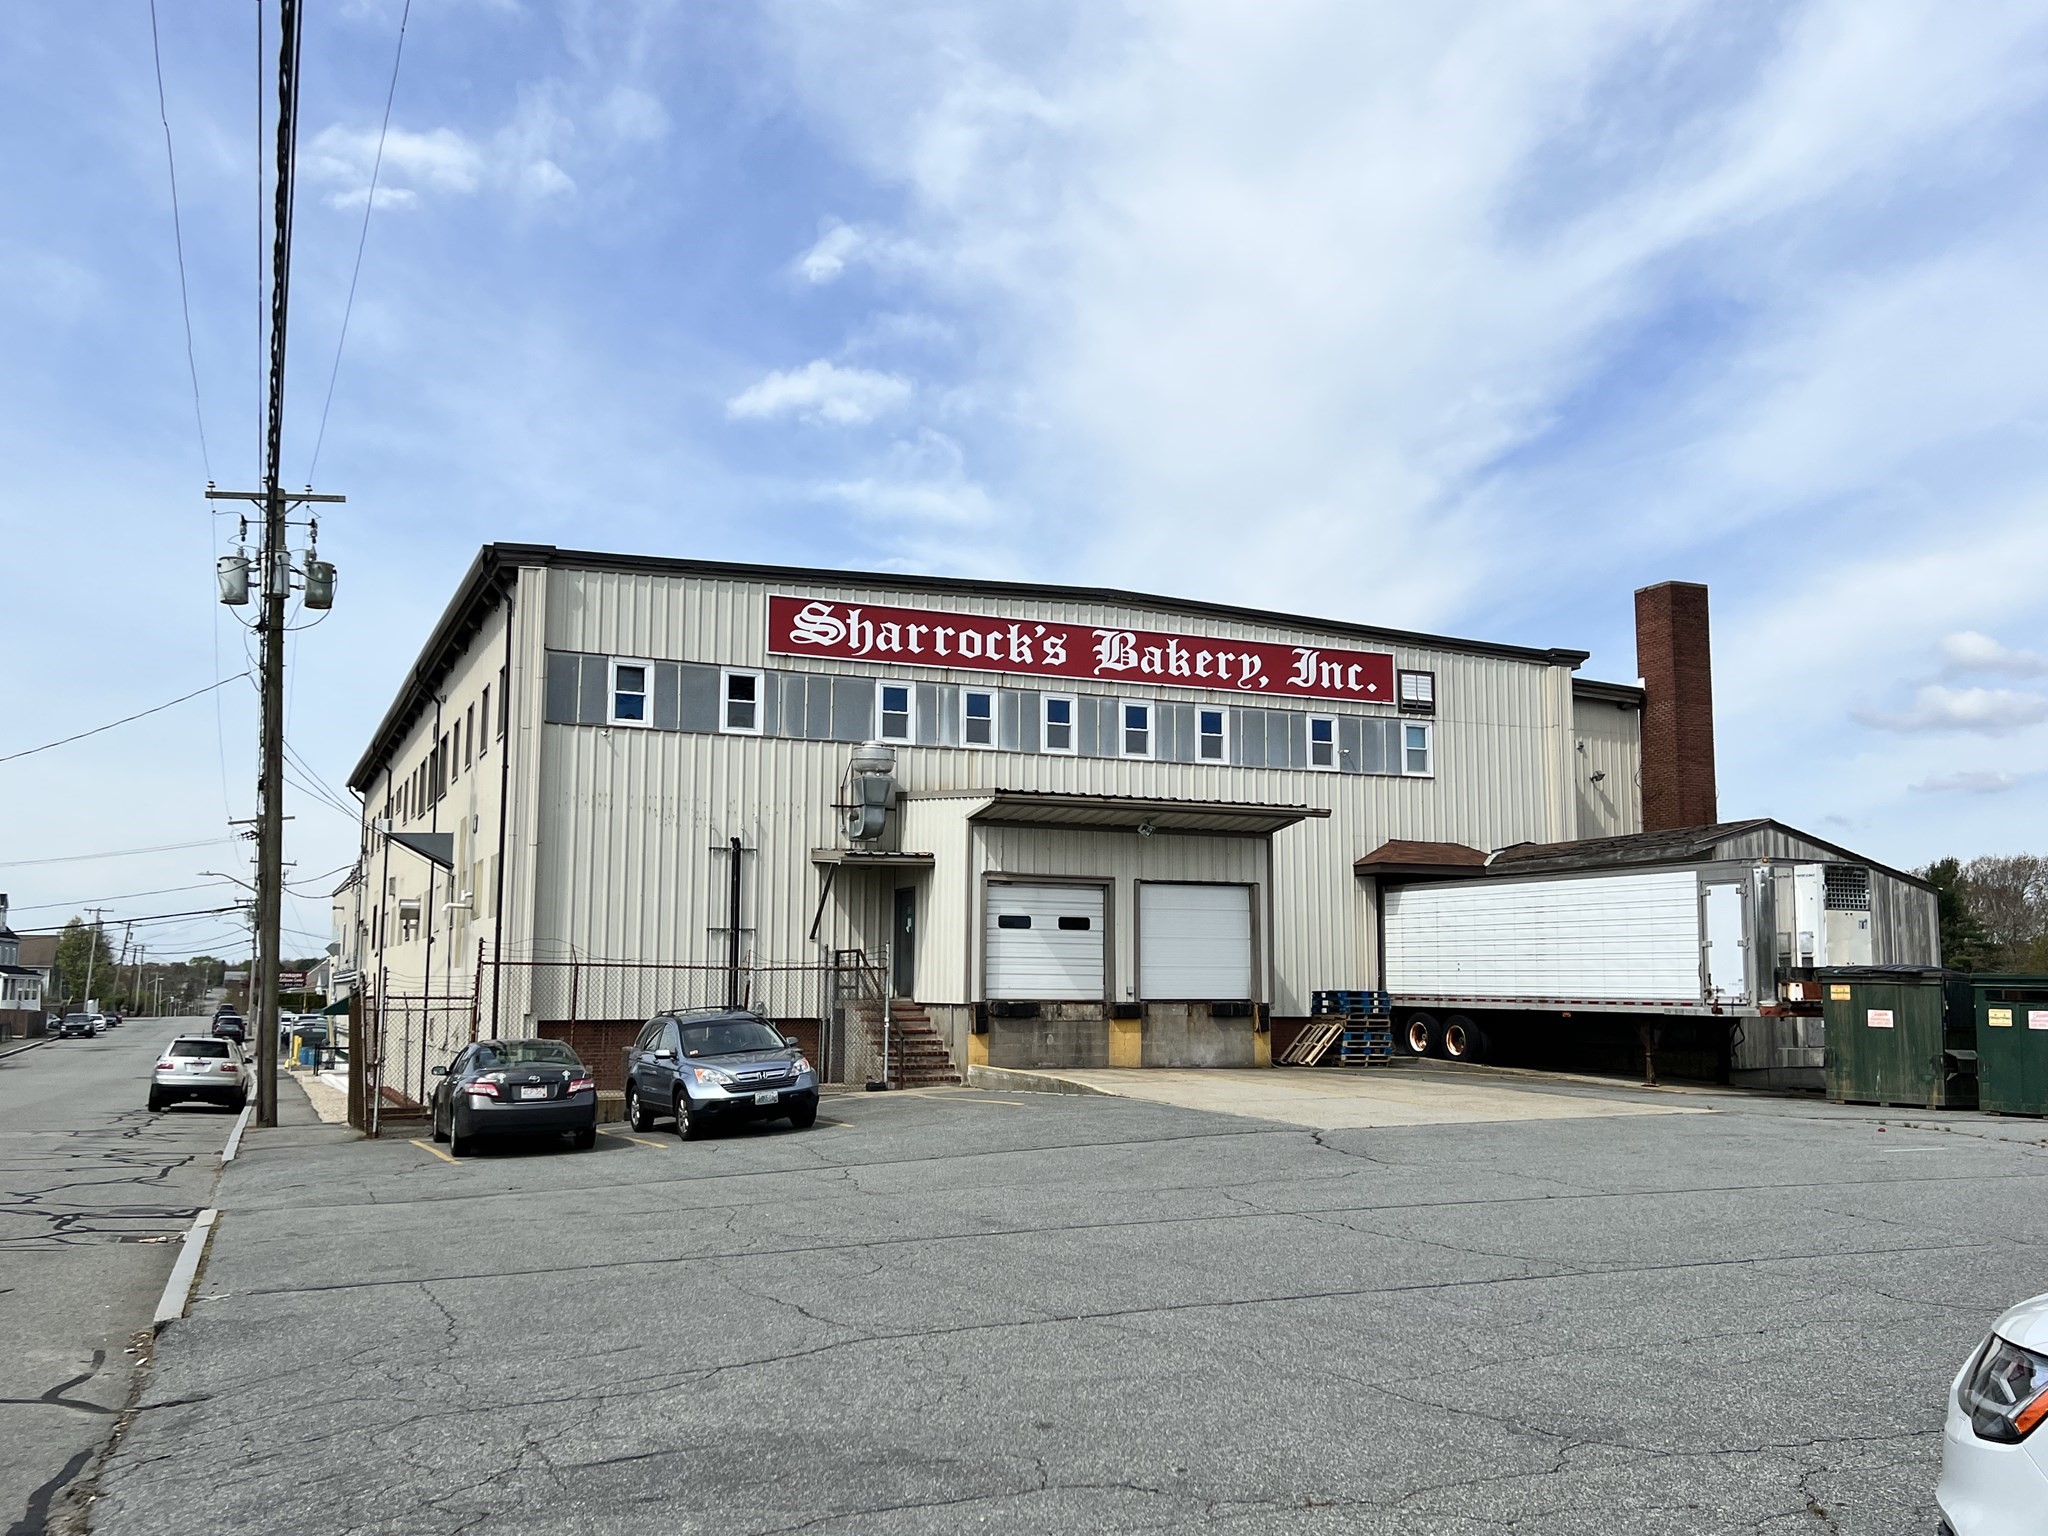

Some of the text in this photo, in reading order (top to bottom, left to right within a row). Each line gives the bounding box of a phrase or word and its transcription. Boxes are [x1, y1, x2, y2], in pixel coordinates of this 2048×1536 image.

[789, 601, 1378, 693] Sharrock's Bakery, Inc.
